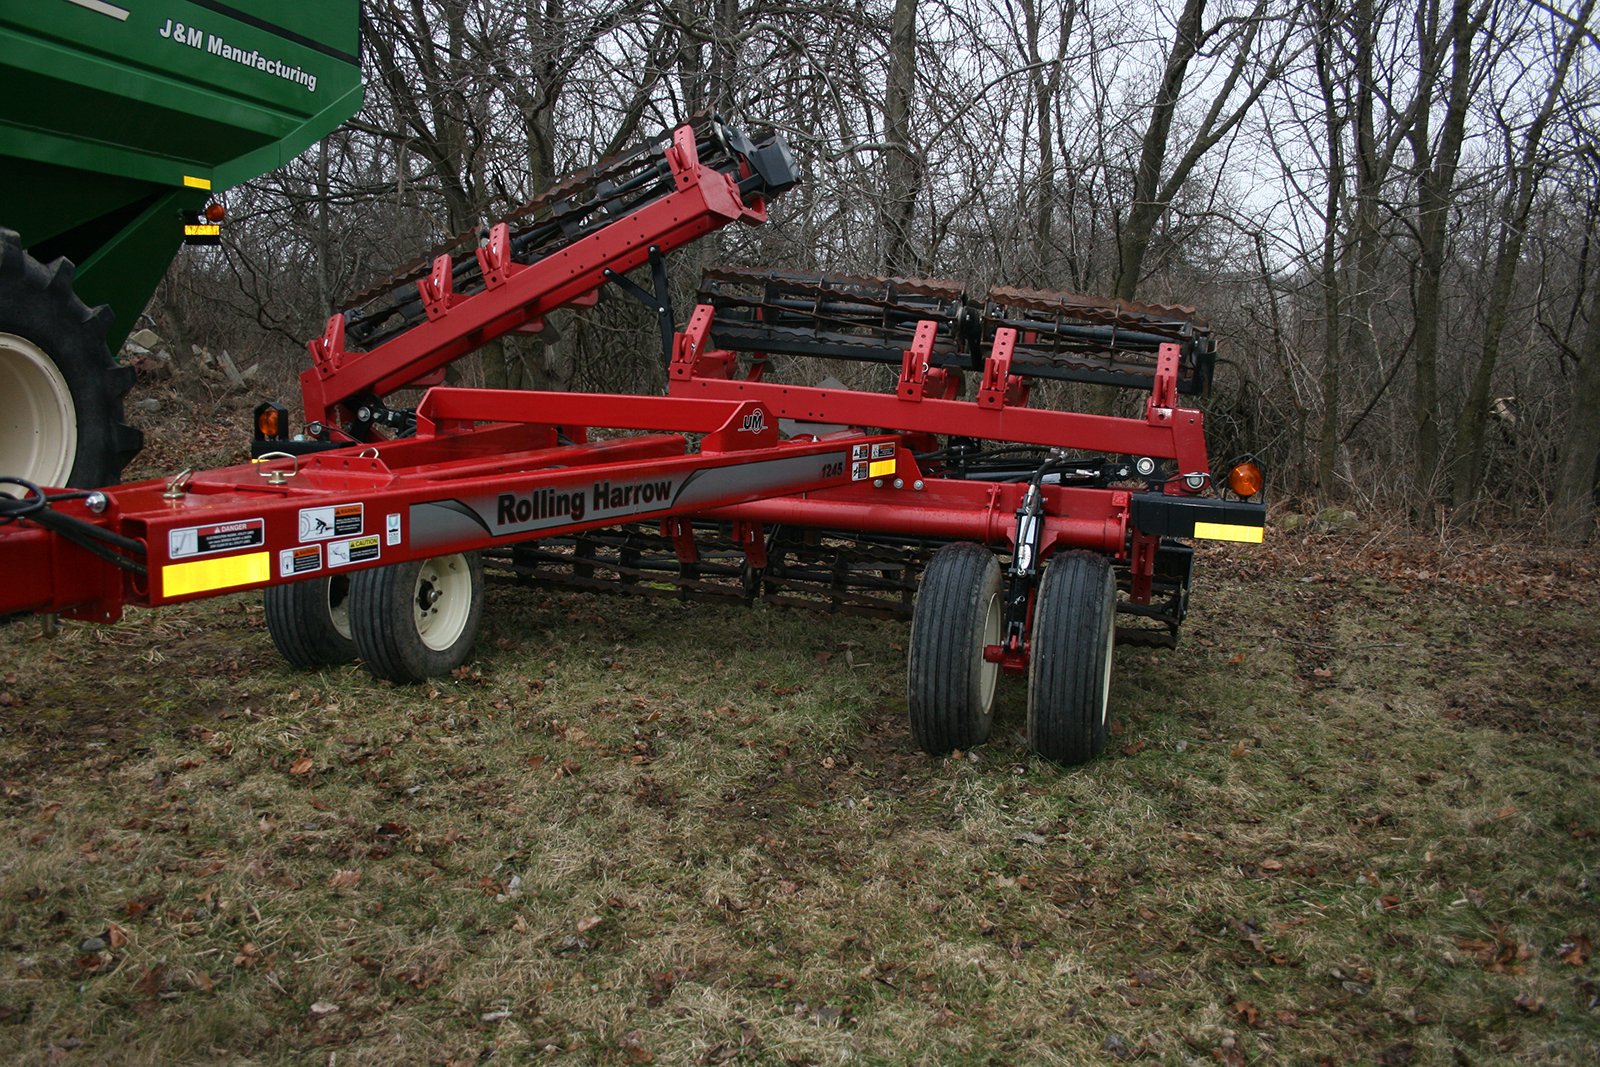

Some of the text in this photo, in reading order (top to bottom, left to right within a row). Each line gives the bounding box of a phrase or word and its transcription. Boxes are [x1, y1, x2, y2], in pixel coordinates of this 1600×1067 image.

[159, 18, 317, 92] J&M Manufacturing
[822, 462, 843, 478] 1245
[497, 481, 672, 521] Rolling Harrow
[221, 523, 248, 533] DANGER
[355, 537, 378, 547] CAUTION
